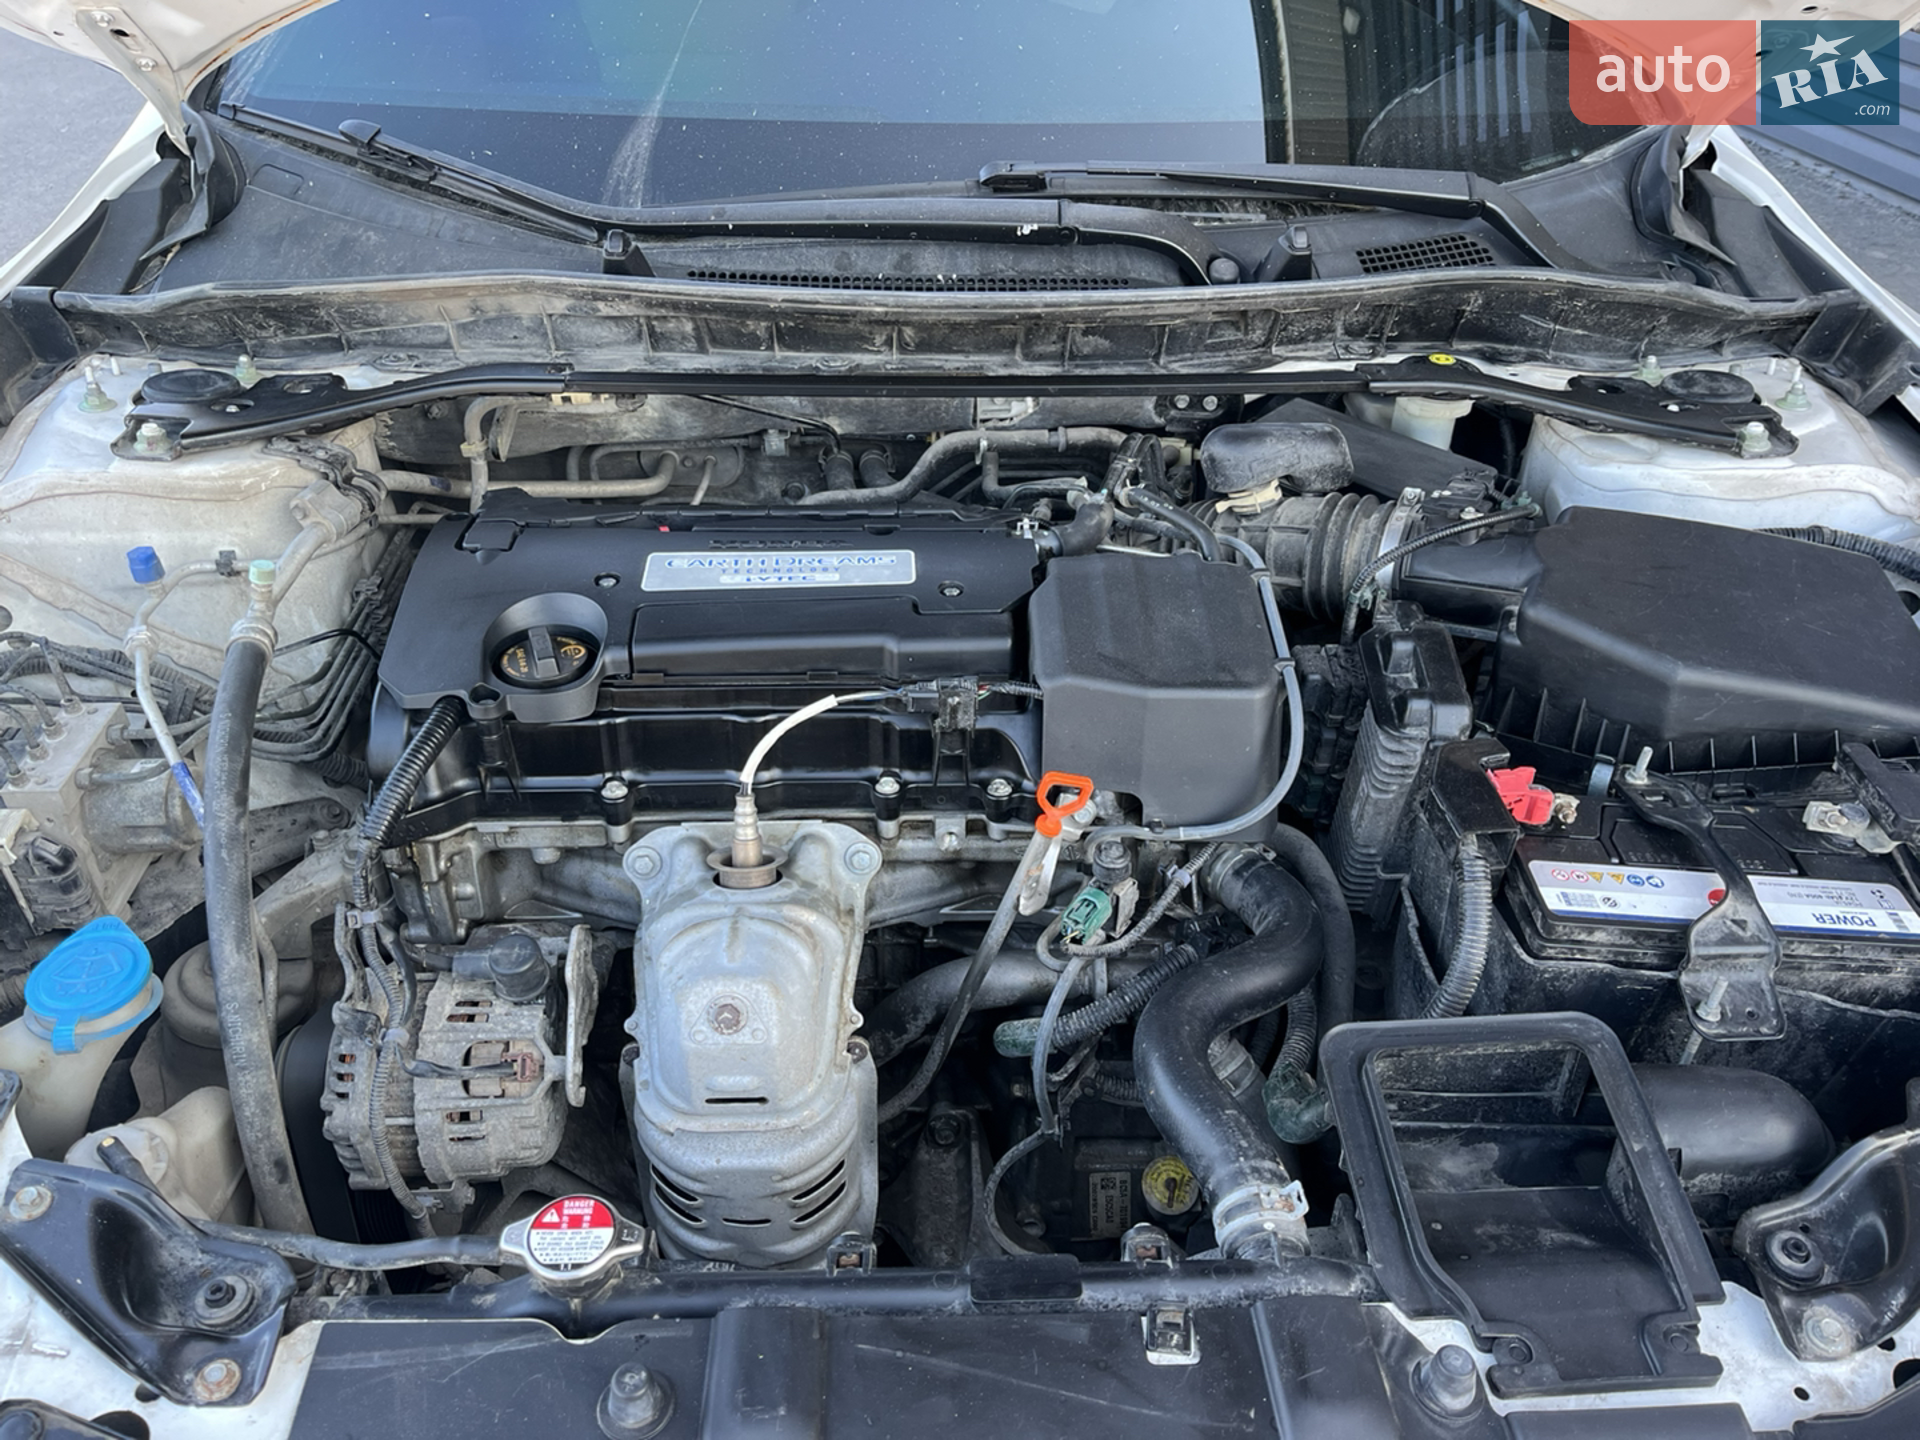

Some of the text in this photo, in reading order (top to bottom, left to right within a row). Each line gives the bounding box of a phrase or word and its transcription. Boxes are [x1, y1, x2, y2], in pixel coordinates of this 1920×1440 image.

[664, 555, 898, 568] EARTH DREAMS
[721, 566, 842, 574] TECHNOLOGY
[1811, 912, 1877, 928] POWER
[564, 1200, 595, 1208] DANGER
